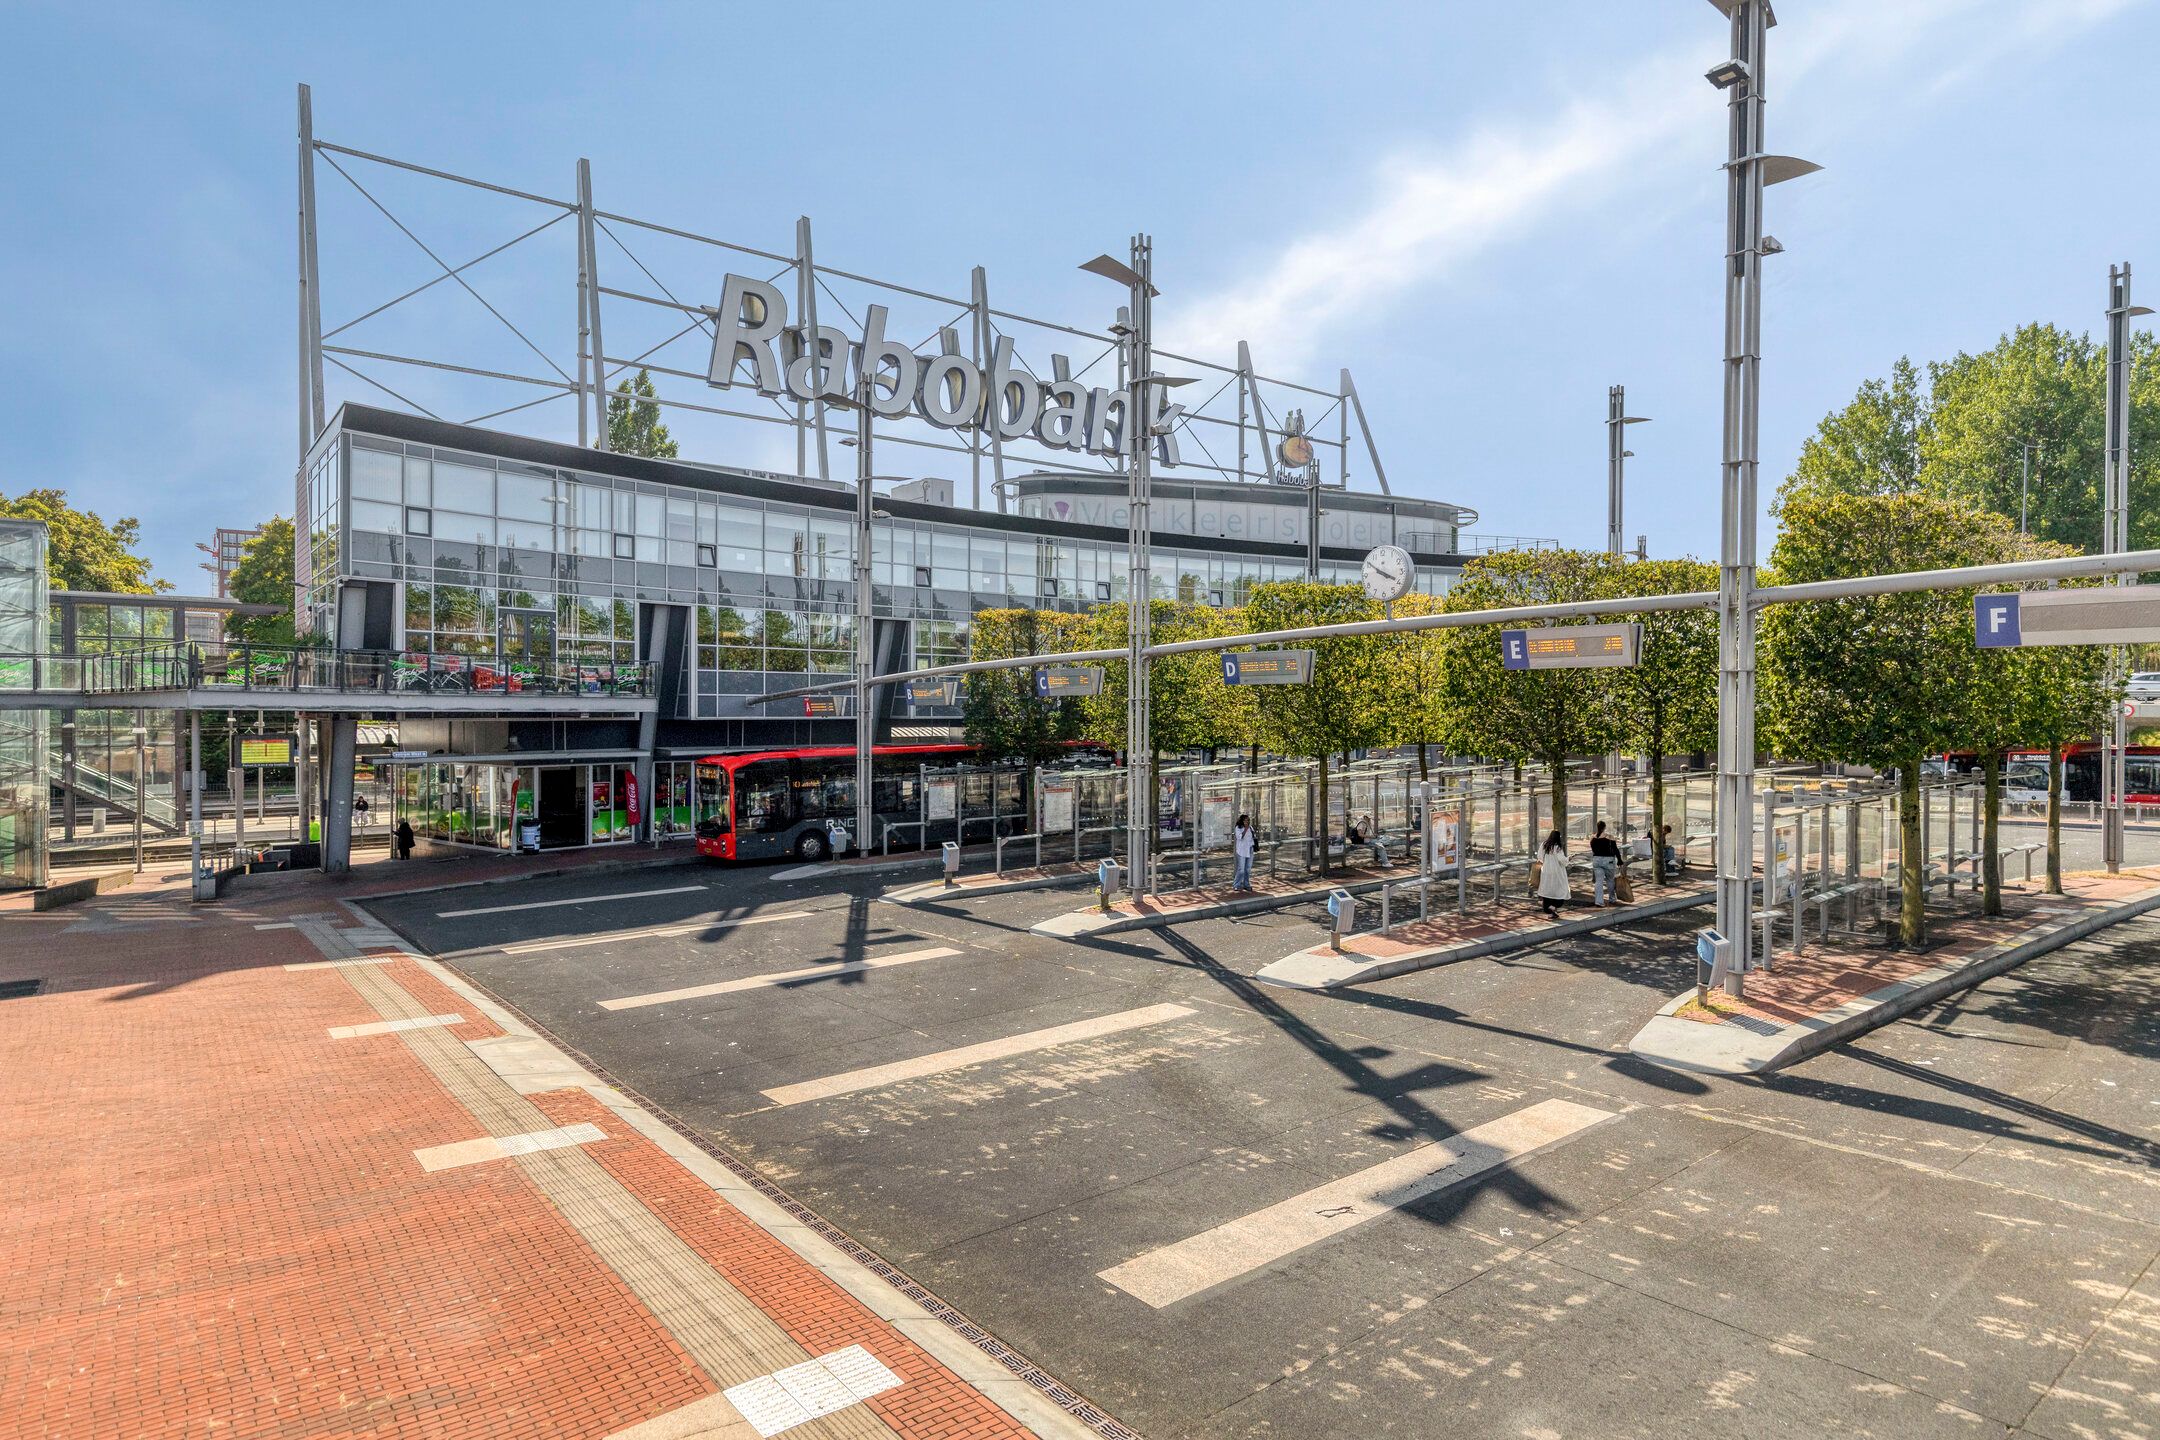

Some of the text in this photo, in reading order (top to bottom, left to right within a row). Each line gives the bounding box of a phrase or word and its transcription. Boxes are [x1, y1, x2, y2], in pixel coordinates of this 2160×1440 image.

[708, 273, 1186, 466] Rabobank
[1990, 607, 2007, 633] F
[1510, 640, 1522, 660] E
[1225, 661, 1236, 677] D
[1040, 677, 1047, 690] C
[906, 688, 912, 700] B
[806, 702, 811, 712] A
